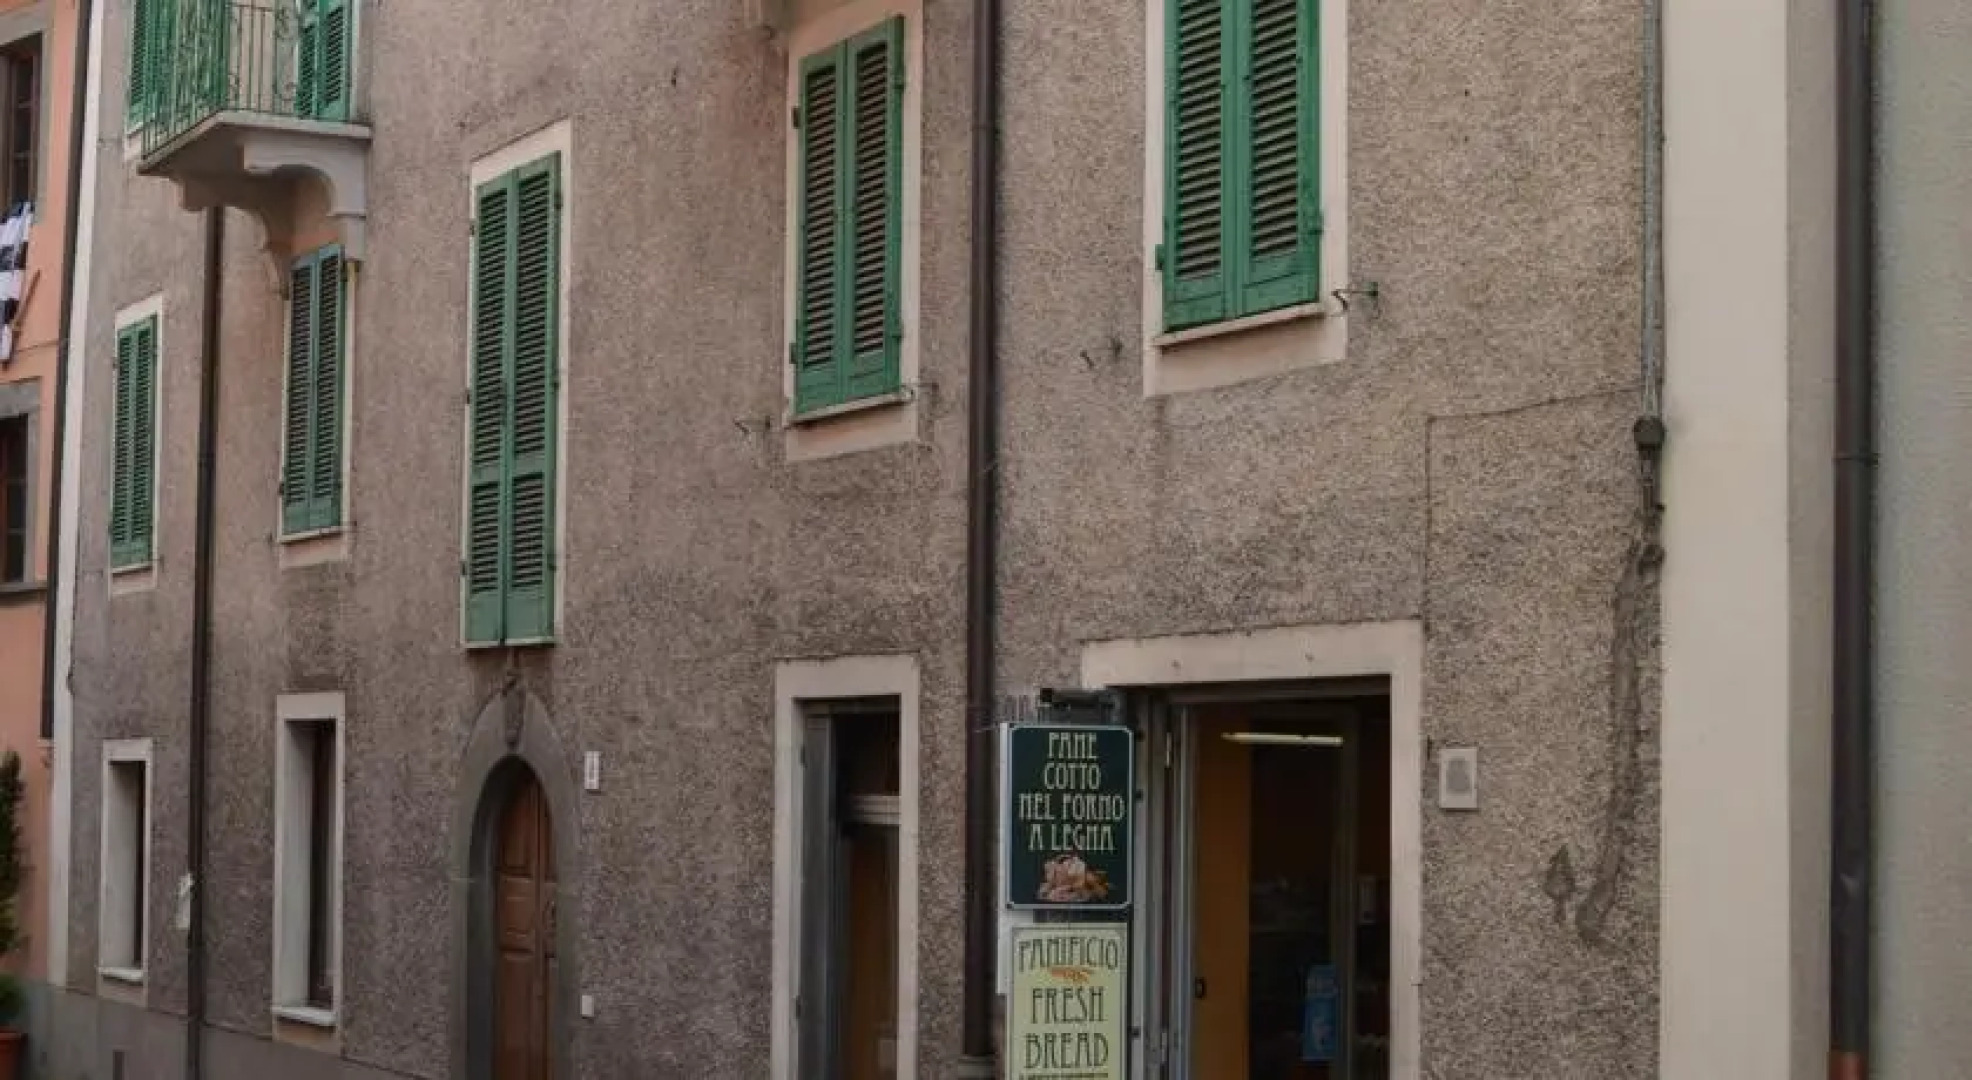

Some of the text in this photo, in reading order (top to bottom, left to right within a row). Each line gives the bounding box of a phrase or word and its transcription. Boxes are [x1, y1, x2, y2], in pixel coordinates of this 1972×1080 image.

[1048, 732, 1098, 759] PANE
[1044, 762, 1101, 790] COTTO
[1019, 793, 1125, 820] NEL FORNO
[1028, 824, 1115, 851] A LEGNA
[1018, 936, 1118, 972] PANIFICIO
[1031, 986, 1106, 1024] FRESH
[1024, 1032, 1109, 1068] BREAD
